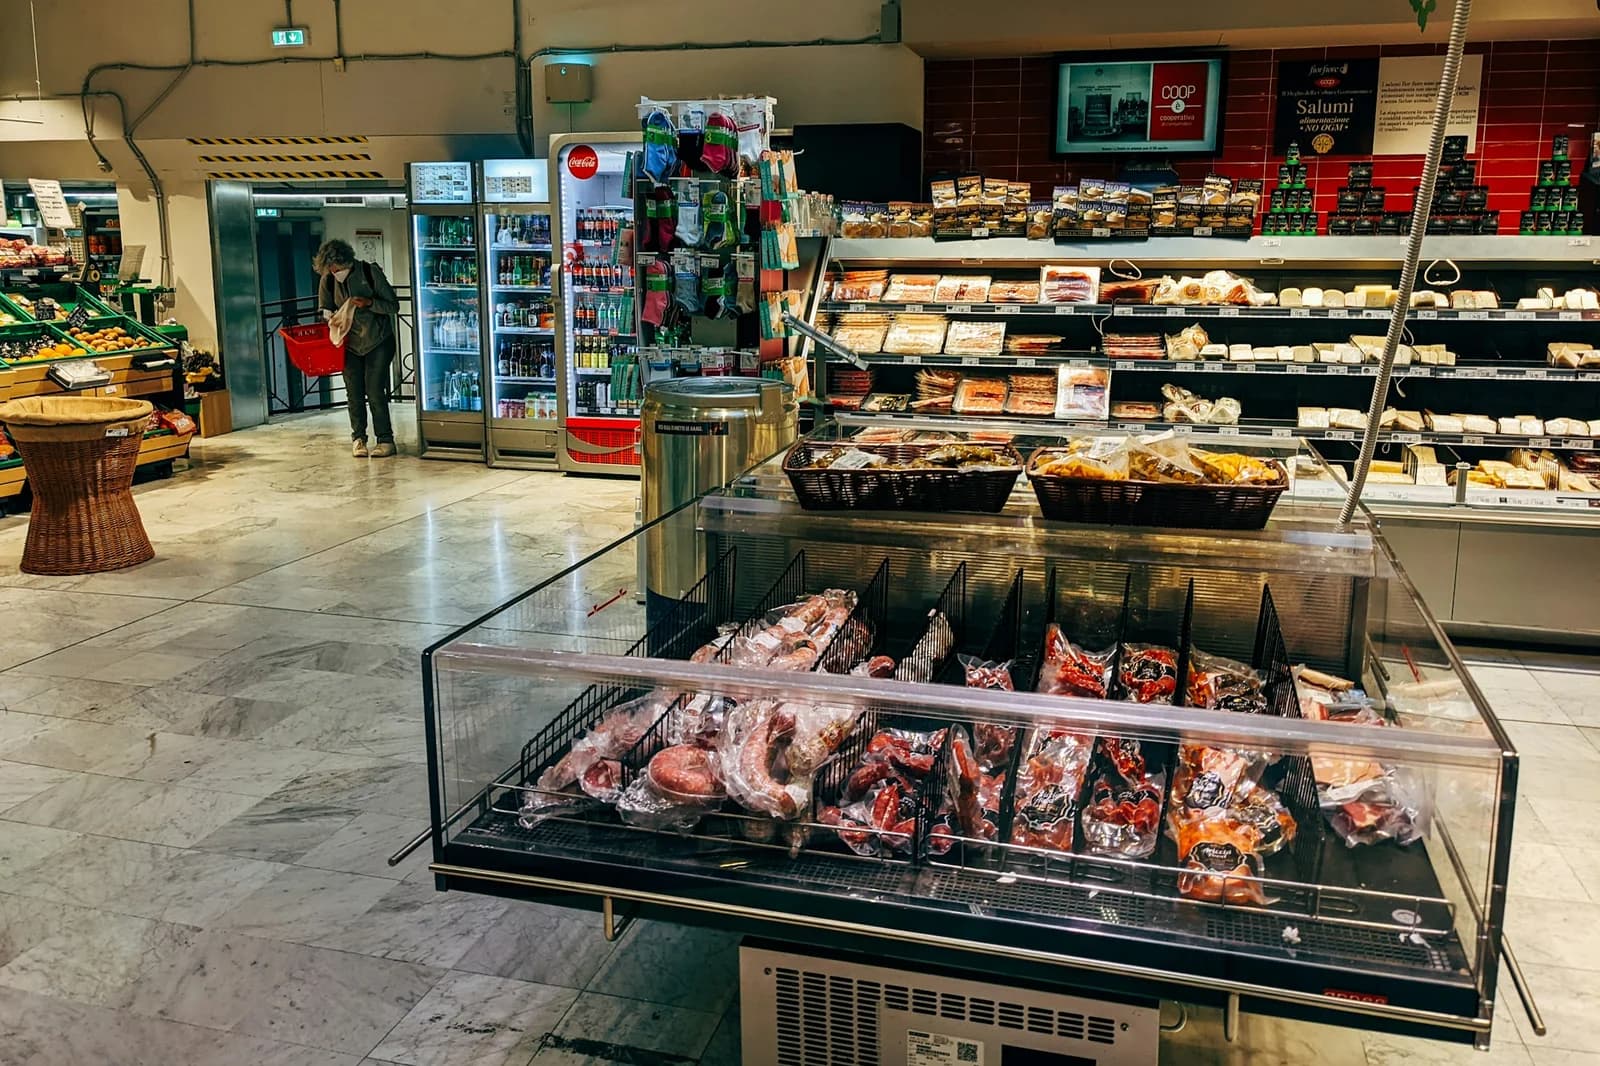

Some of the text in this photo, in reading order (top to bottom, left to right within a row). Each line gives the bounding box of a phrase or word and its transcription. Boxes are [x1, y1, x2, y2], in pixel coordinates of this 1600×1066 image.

[1162, 85, 1196, 99] COOP
[1296, 98, 1354, 115] Salumi
[1299, 116, 1350, 124] alimentazione
[1305, 123, 1343, 132] NO OGM
[569, 156, 596, 168] Coca-Cola
